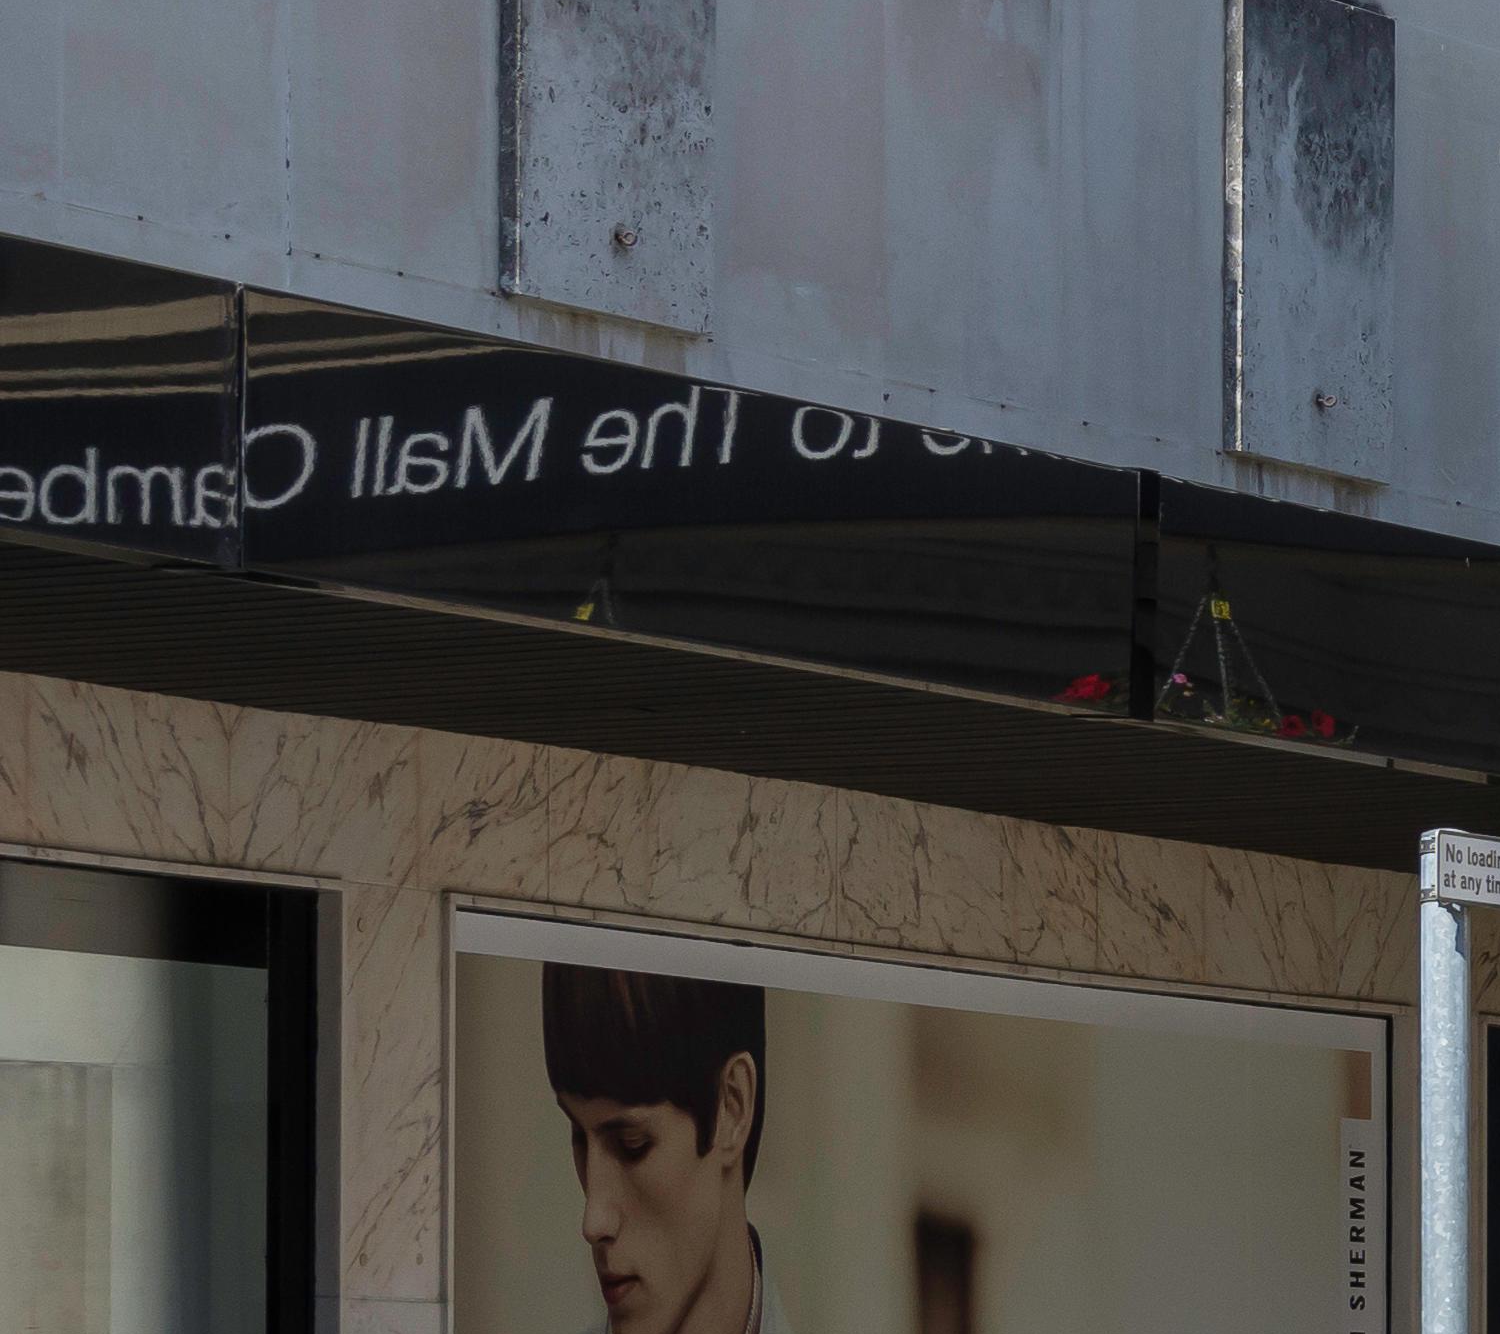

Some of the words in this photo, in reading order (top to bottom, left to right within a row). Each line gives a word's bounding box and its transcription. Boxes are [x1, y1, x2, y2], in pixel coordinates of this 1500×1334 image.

[1445, 842, 1463, 864] No
[1443, 870, 1456, 888] at
[1460, 875, 1482, 896] any
[1349, 1150, 1366, 1310] SHERMAN
